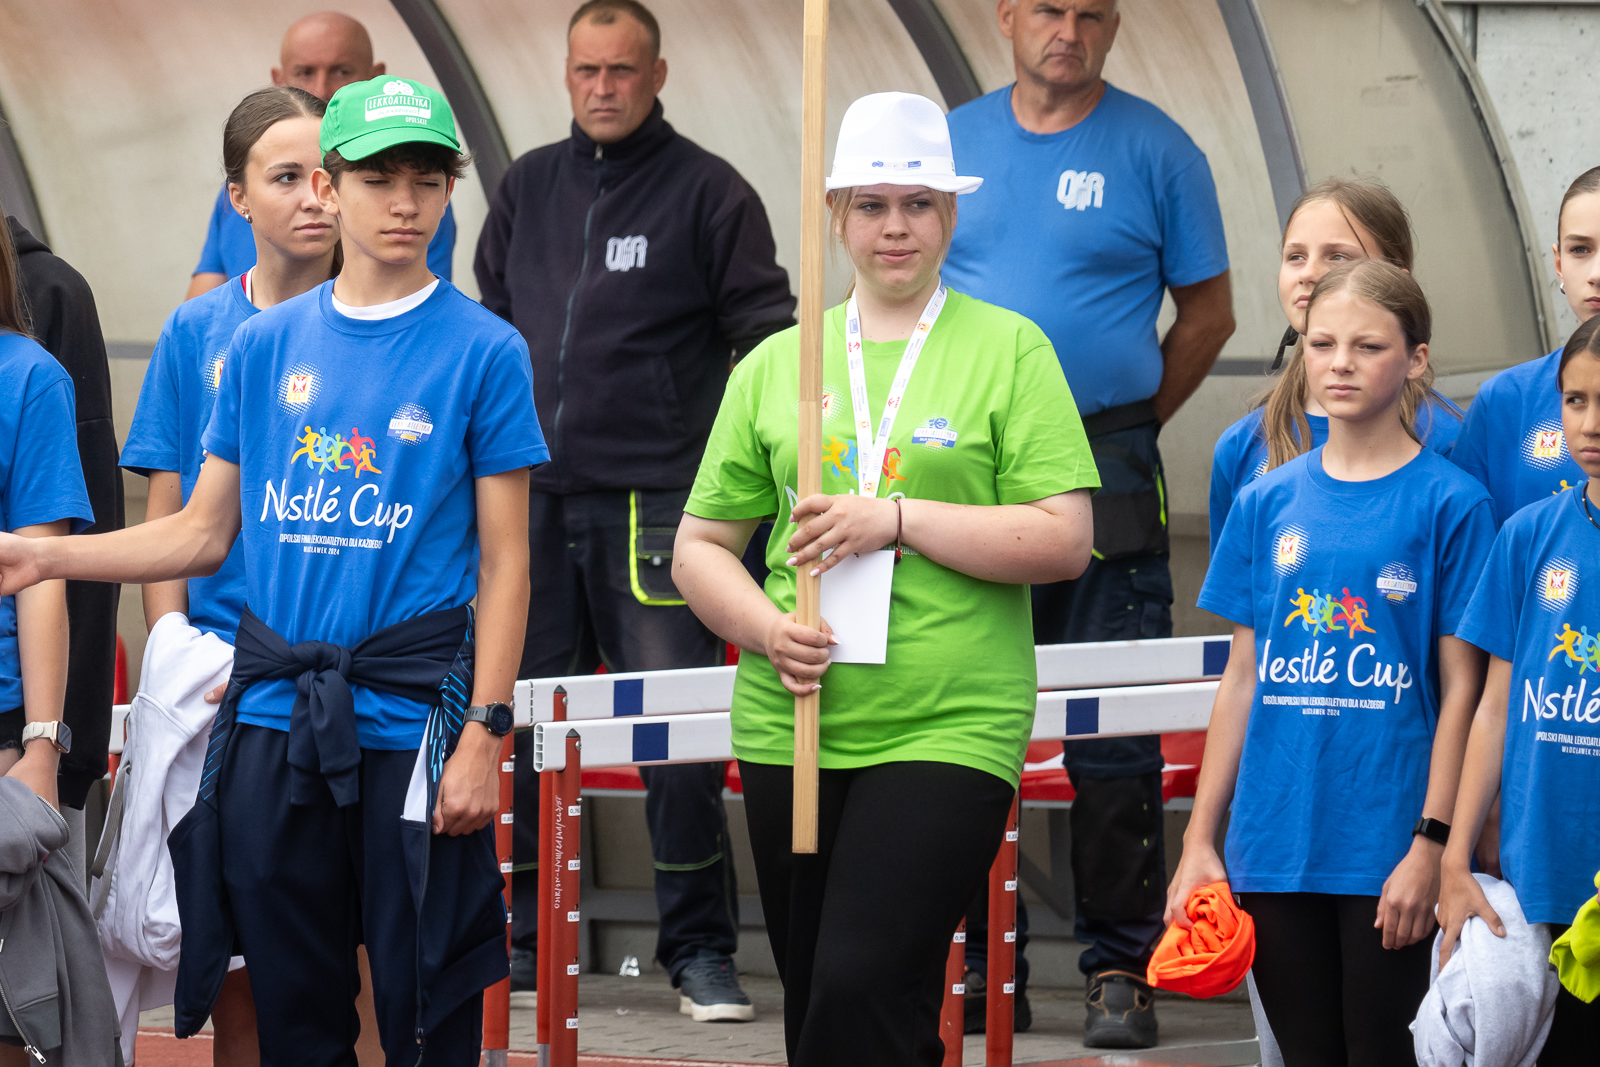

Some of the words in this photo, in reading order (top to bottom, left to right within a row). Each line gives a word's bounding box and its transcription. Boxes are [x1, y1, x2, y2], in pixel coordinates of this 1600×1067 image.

[368, 95, 428, 110] LEKKOATLETYKA
[405, 116, 428, 126] OPOLSKIE
[1535, 447, 1558, 457] PZLA
[260, 478, 342, 523] Nstlé
[349, 482, 414, 544] Cup
[358, 537, 383, 550] KAŻDEGO
[1346, 643, 1413, 705] Cup
[1521, 676, 1600, 724] Nstlé
